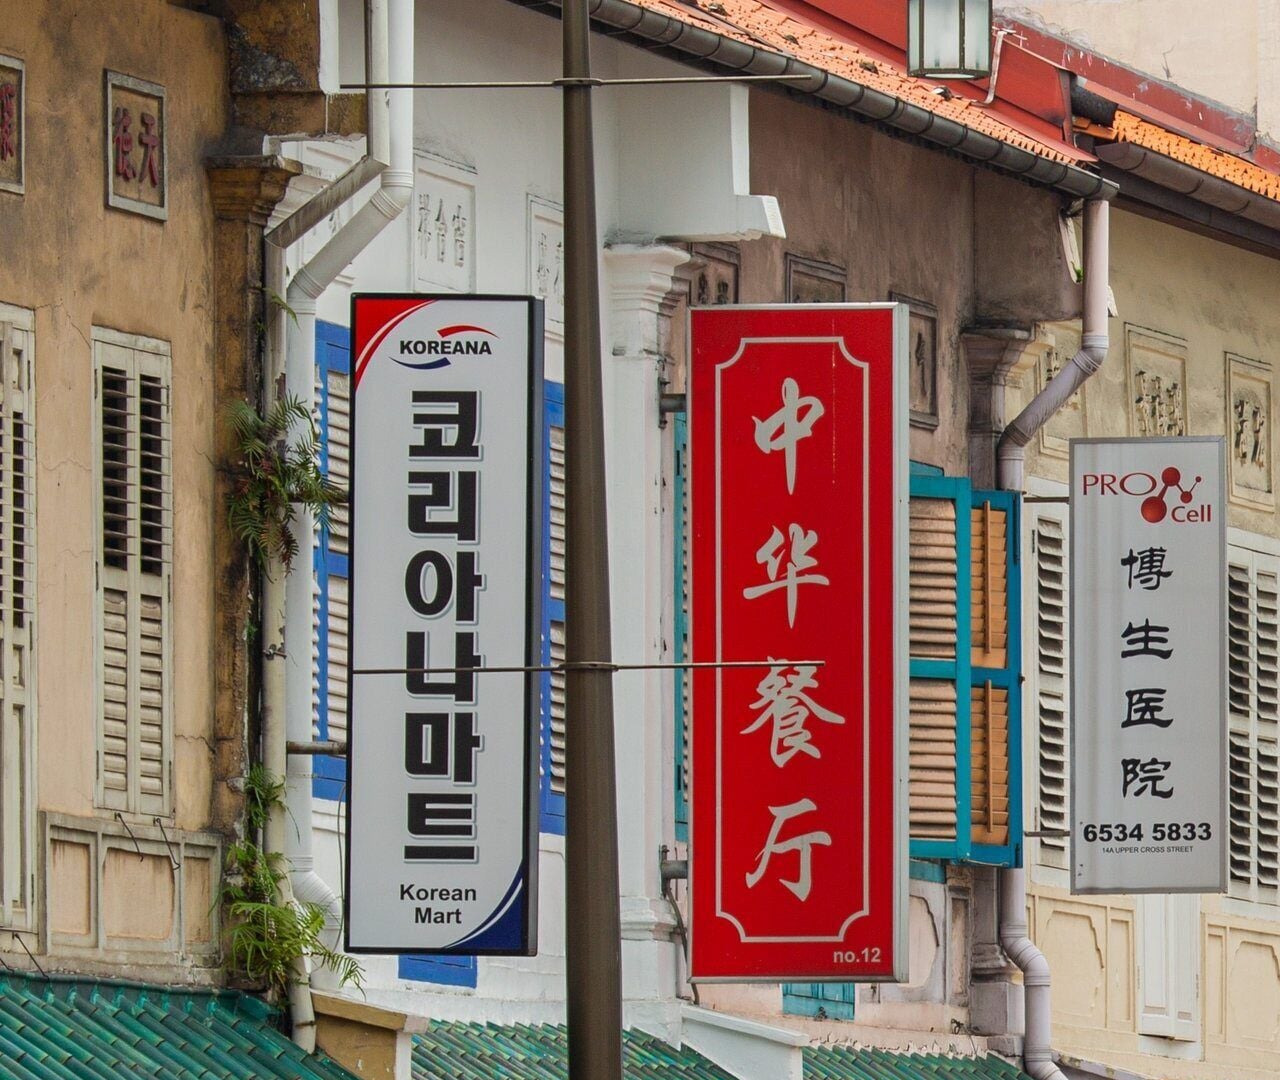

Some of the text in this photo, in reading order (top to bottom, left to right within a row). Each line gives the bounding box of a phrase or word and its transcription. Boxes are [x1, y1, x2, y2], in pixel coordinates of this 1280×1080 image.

[399, 338, 491, 356] KOREANA
[1083, 473, 1157, 496] PRO
[1172, 505, 1211, 522] Cell
[403, 390, 485, 862] 코리아나마트
[740, 377, 845, 901] 中华餐厅
[1120, 546, 1174, 799] 博生医院
[1083, 822, 1212, 842] 6534 5833
[1115, 846, 1139, 854] UPPER
[1167, 845, 1193, 853] STREET
[399, 883, 477, 901] Korean
[414, 906, 462, 924] Mart
[833, 947, 881, 963] no.12
